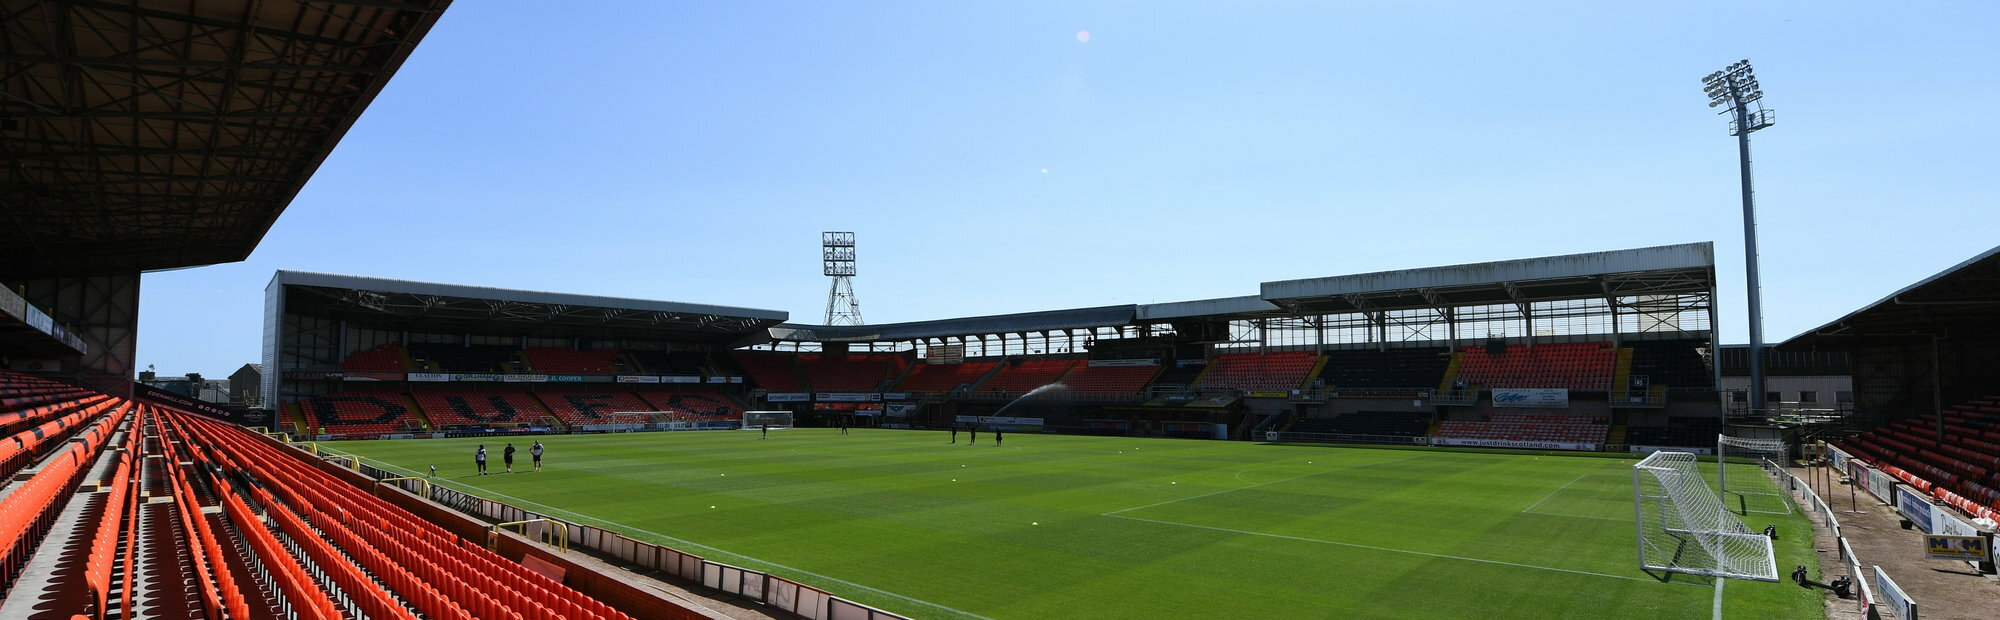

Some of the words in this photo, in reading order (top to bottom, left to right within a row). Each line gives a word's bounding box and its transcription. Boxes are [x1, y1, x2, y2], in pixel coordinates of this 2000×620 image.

[147, 390, 193, 407] EDENMILL.COM
[1460, 439, 1561, 449] www.justdrinkscotland.com
[1929, 537, 1982, 551] MKM
